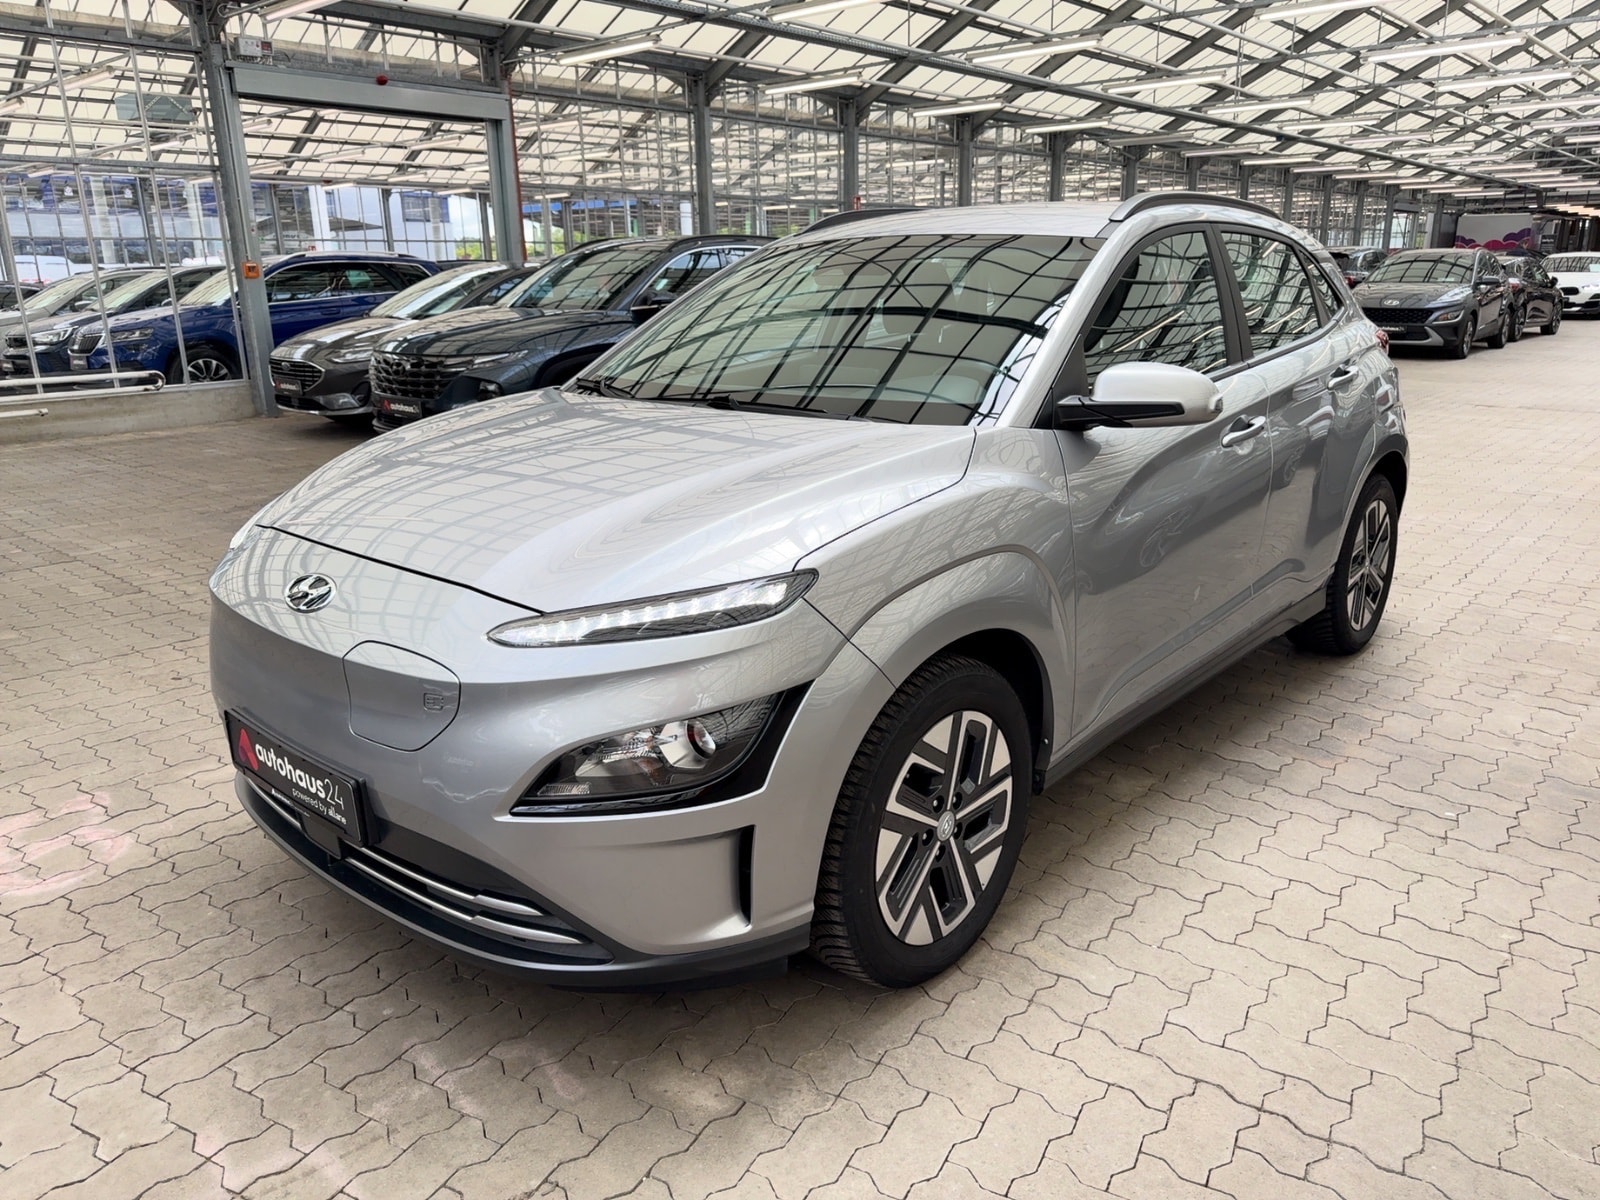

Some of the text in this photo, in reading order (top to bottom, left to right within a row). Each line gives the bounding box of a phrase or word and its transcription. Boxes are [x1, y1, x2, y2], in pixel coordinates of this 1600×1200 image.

[255, 744, 344, 810] autohaus24
[292, 788, 319, 808] powered
[319, 801, 327, 815] by
